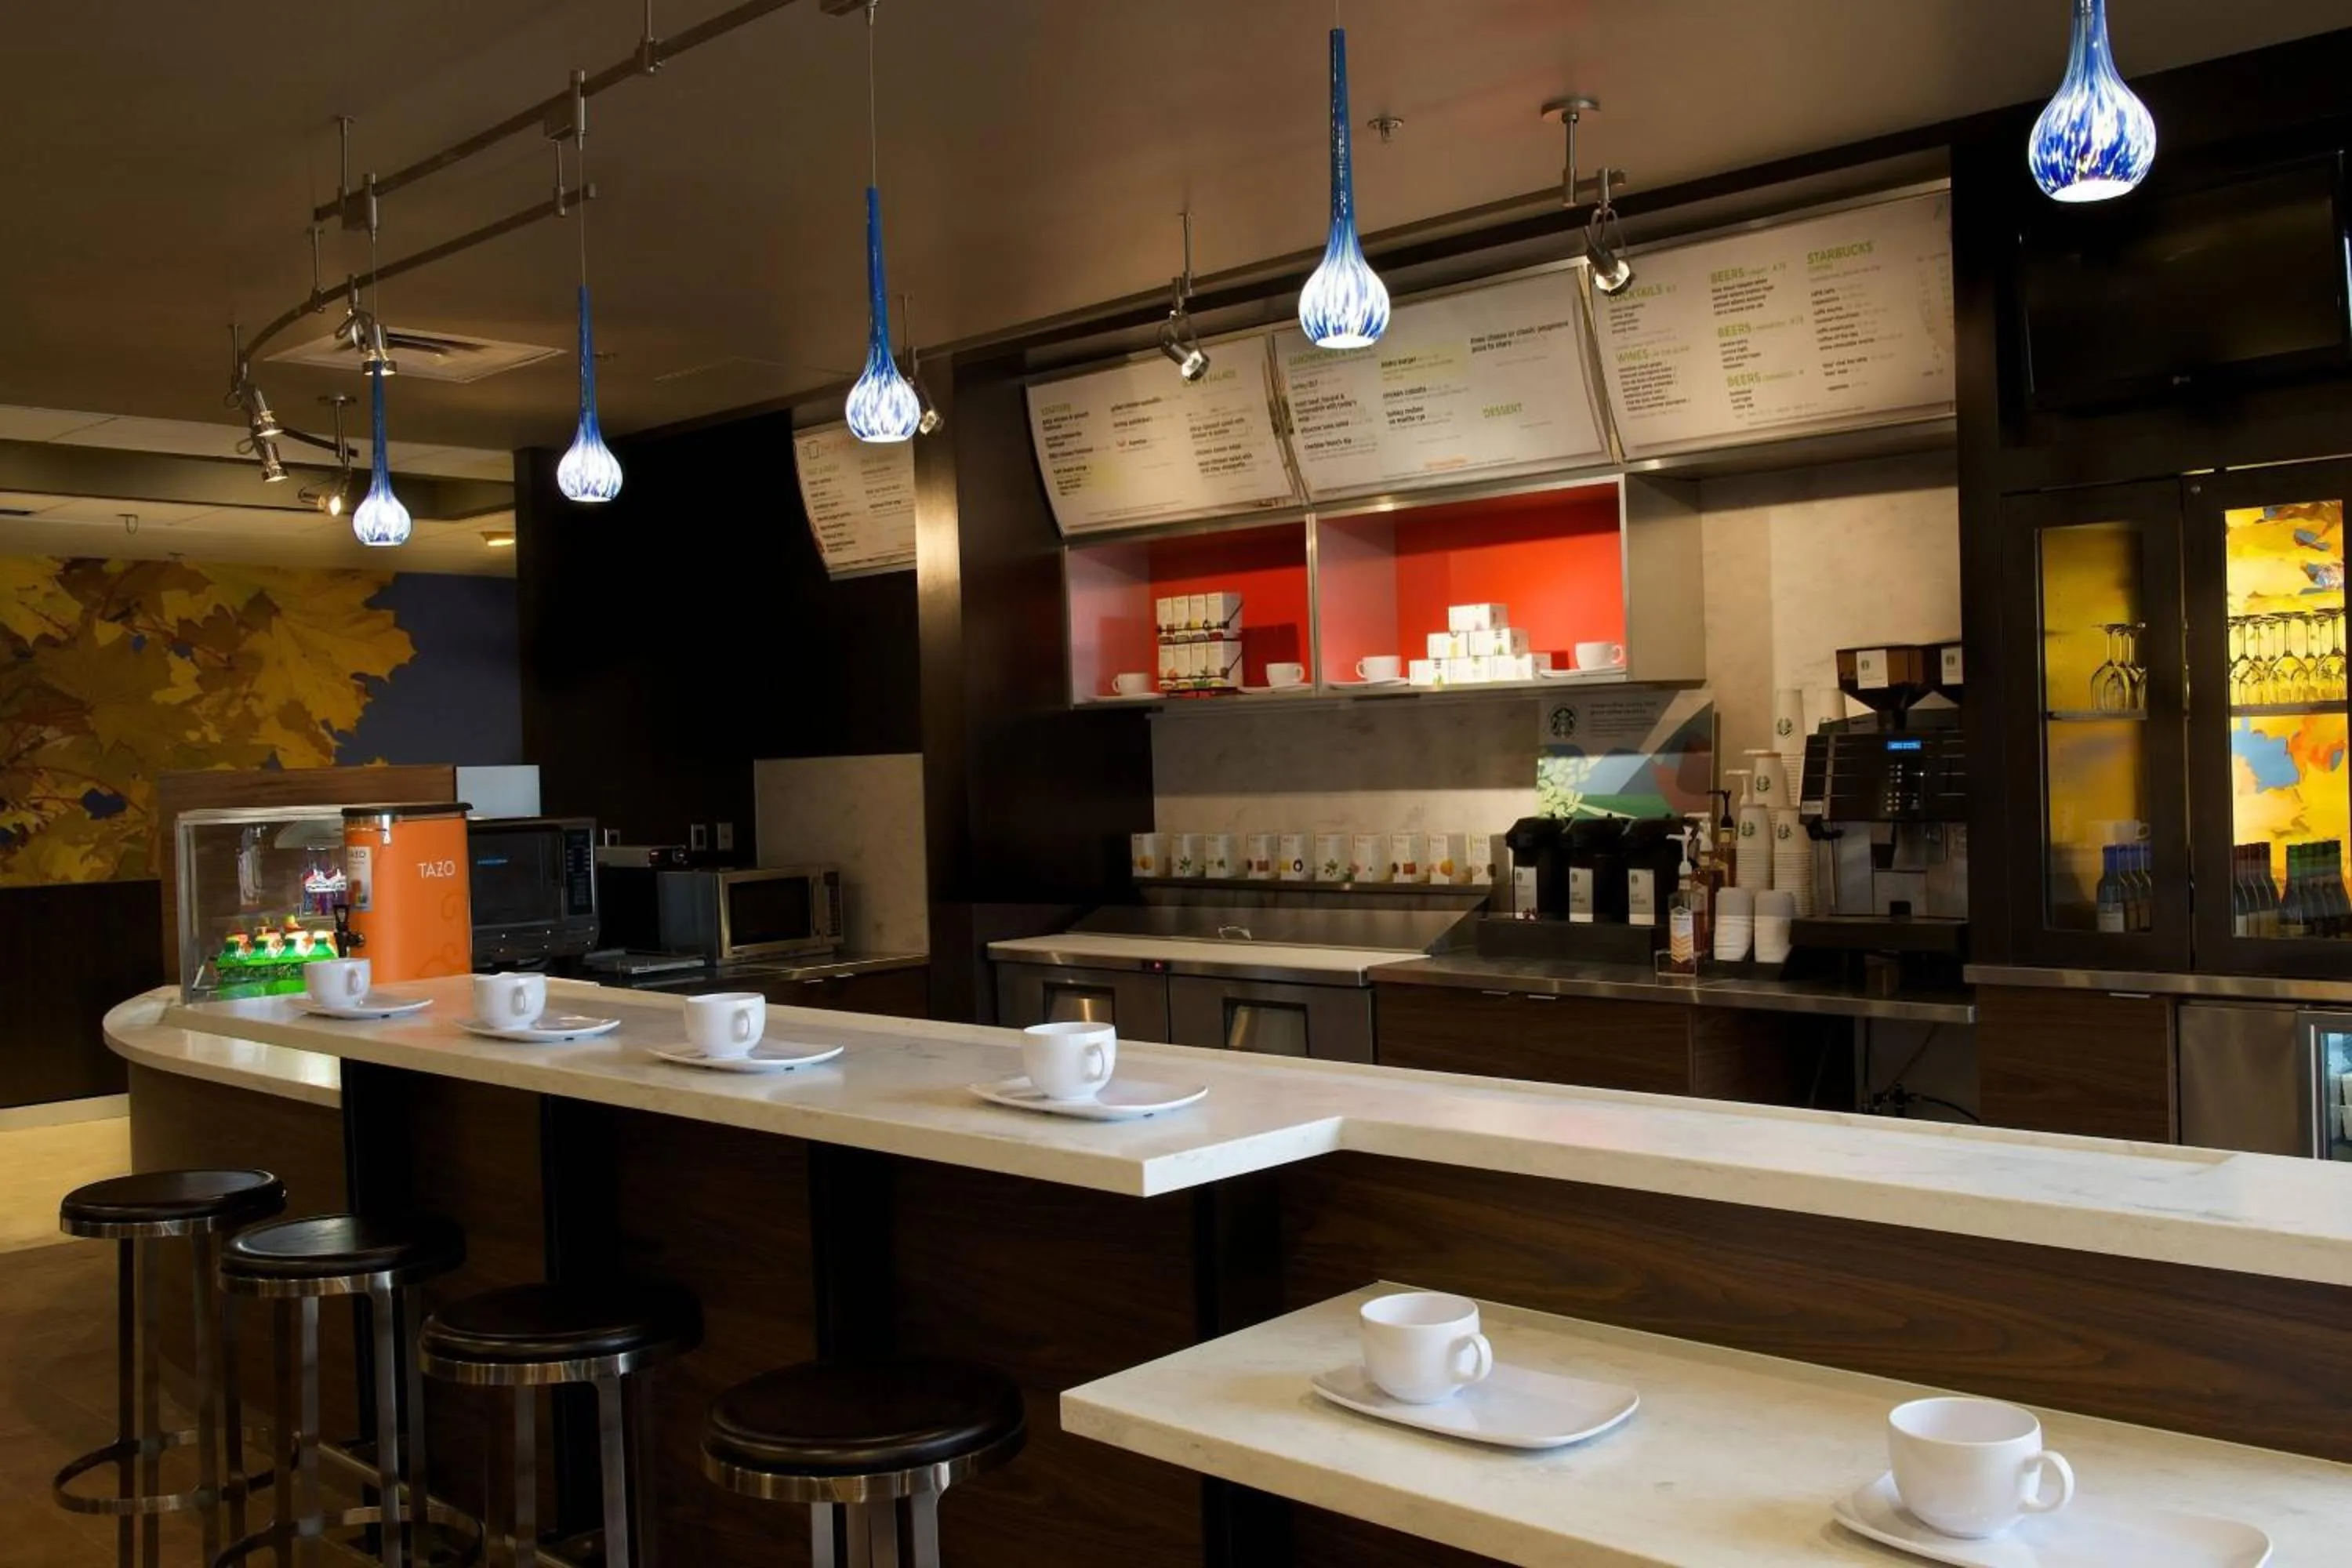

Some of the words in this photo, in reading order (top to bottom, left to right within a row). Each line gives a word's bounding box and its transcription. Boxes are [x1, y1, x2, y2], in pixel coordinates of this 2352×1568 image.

[1806, 241, 1874, 265] STARBUCKS
[1710, 267, 1745, 284] BEERS
[1717, 322, 1751, 338] BEERS
[1616, 348, 1650, 363] WINES
[1726, 372, 1762, 387] BEERS
[1483, 402, 1523, 419] DESSERT
[417, 860, 456, 879] TAZO
